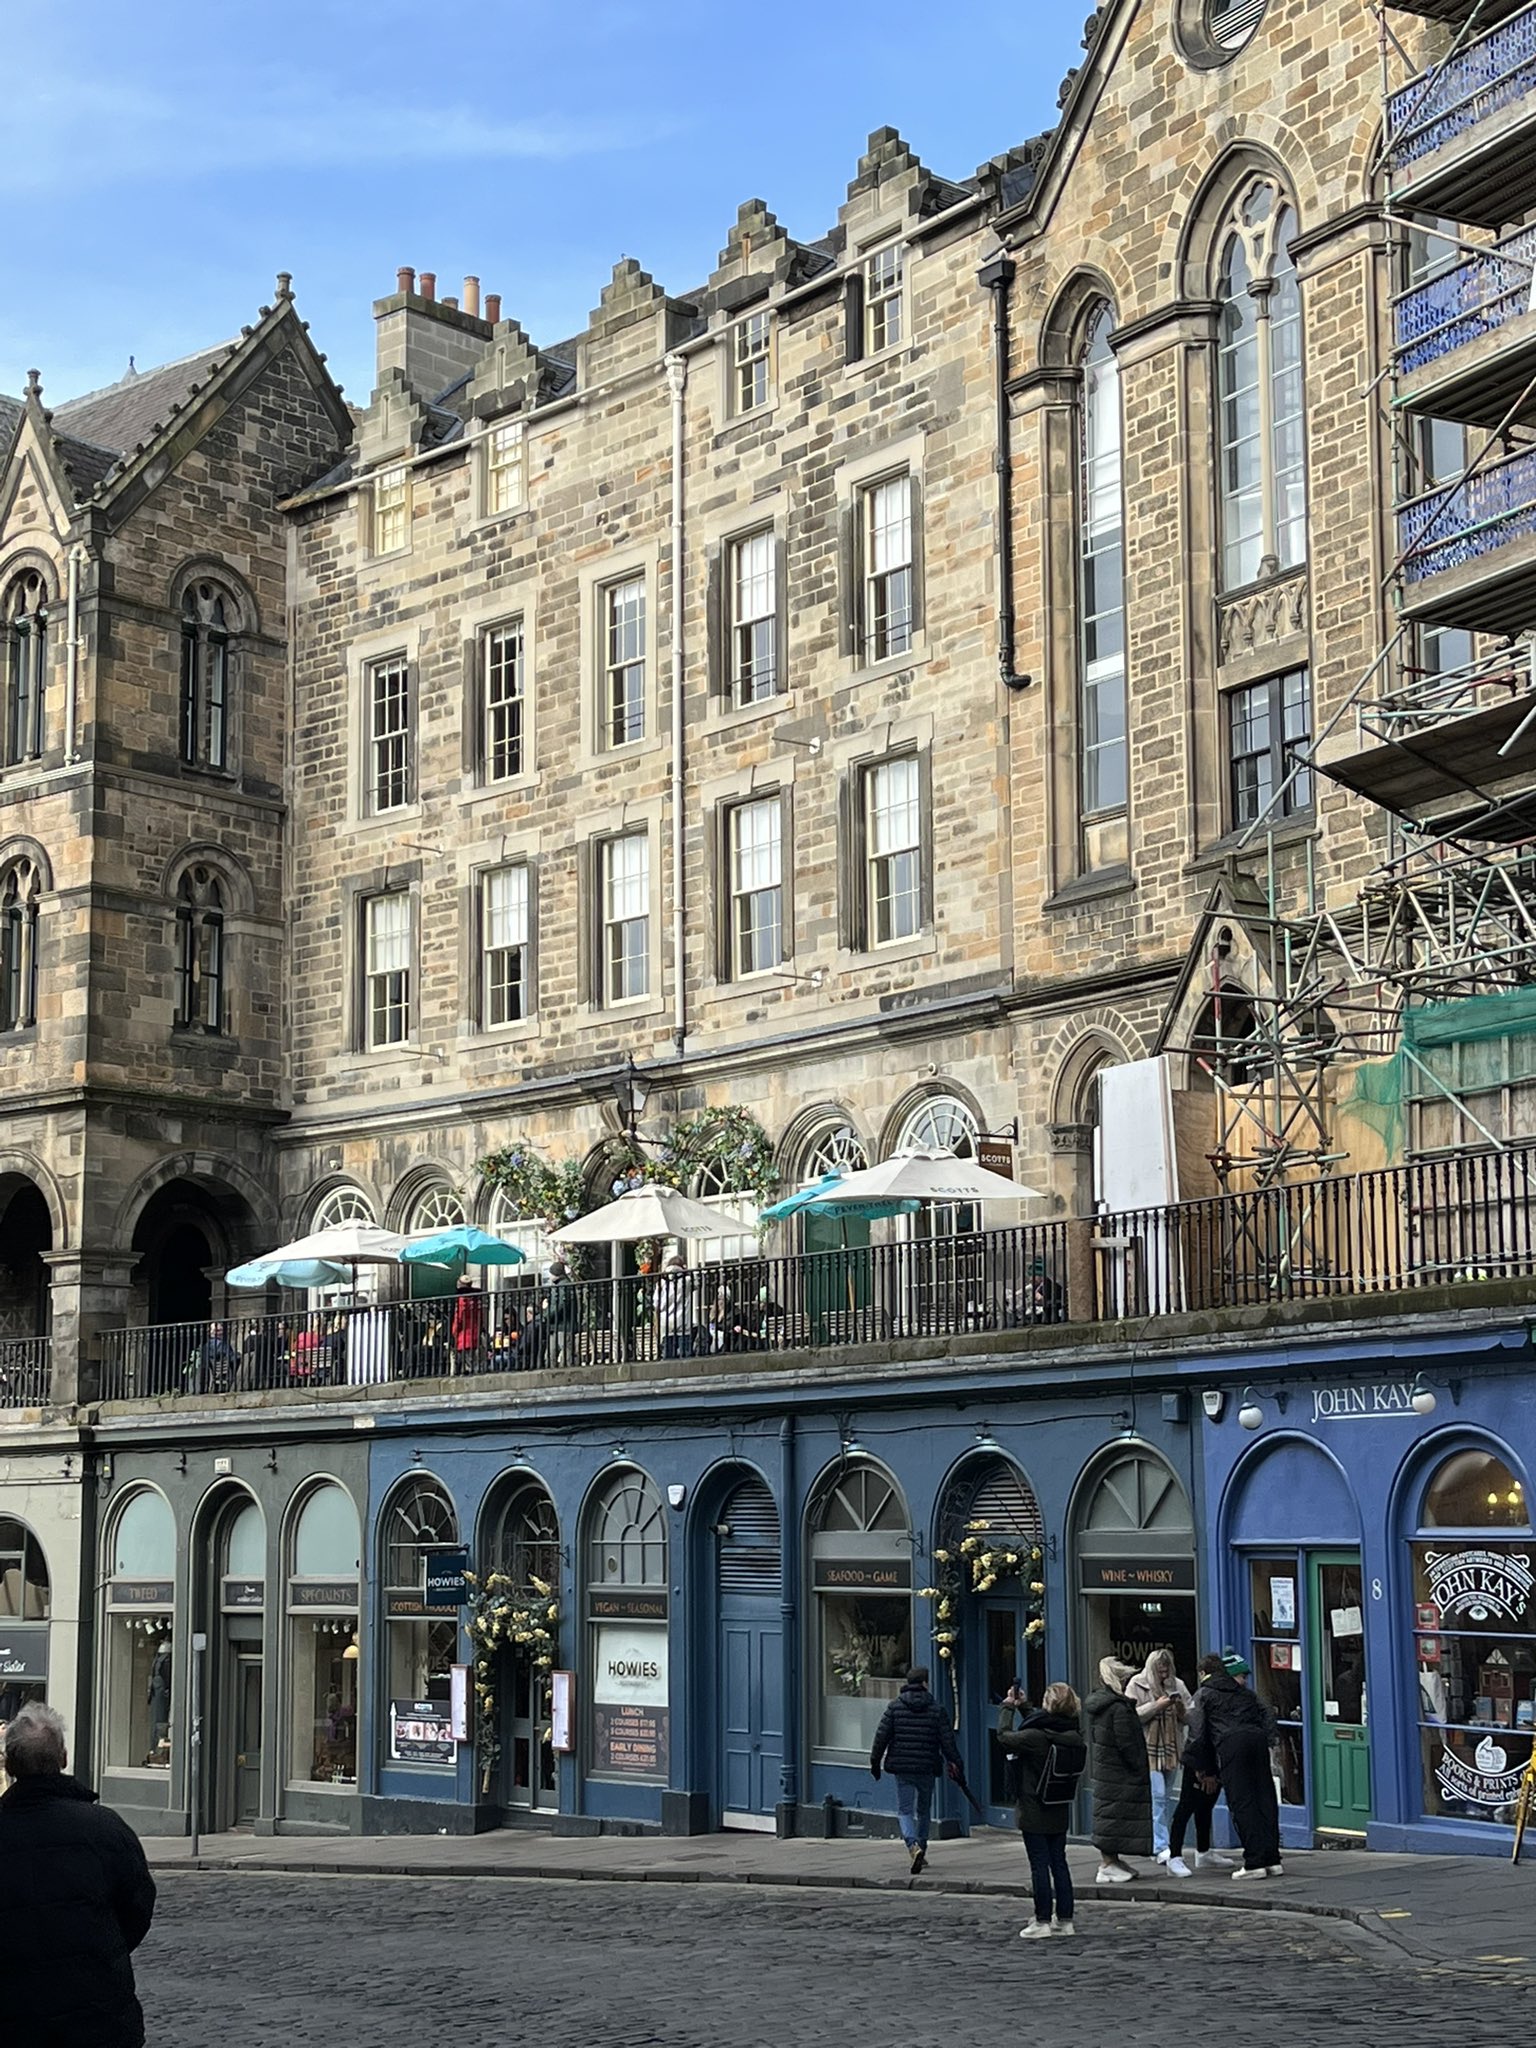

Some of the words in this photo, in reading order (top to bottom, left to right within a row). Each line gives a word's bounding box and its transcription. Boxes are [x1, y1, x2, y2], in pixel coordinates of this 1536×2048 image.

[981, 1154, 1011, 1164] SCOTTS
[1311, 1387, 1366, 1423] JOHN
[428, 1577, 465, 1587] HOWIES
[827, 1570, 864, 1581] SEAFOOD
[873, 1571, 897, 1582] GAME
[1101, 1569, 1127, 1581] WINE
[1136, 1570, 1173, 1582] WHISKY
[129, 1588, 158, 1600] TWEED
[301, 1589, 353, 1601] SPECIALISTS
[1372, 1578, 1382, 1600] 8
[1430, 1569, 1475, 1619] JOHN
[595, 1602, 619, 1613] VEGAN
[627, 1603, 664, 1615] SEASONAL
[608, 1661, 658, 1677] HOWIES
[621, 1706, 645, 1716] LUNCH
[610, 1741, 632, 1751] EARLY
[633, 1743, 656, 1753] DINING
[1442, 1752, 1472, 1783] BOOKS
[1483, 1773, 1518, 1789] PRINTS
[1478, 1788, 1504, 1801] printed
